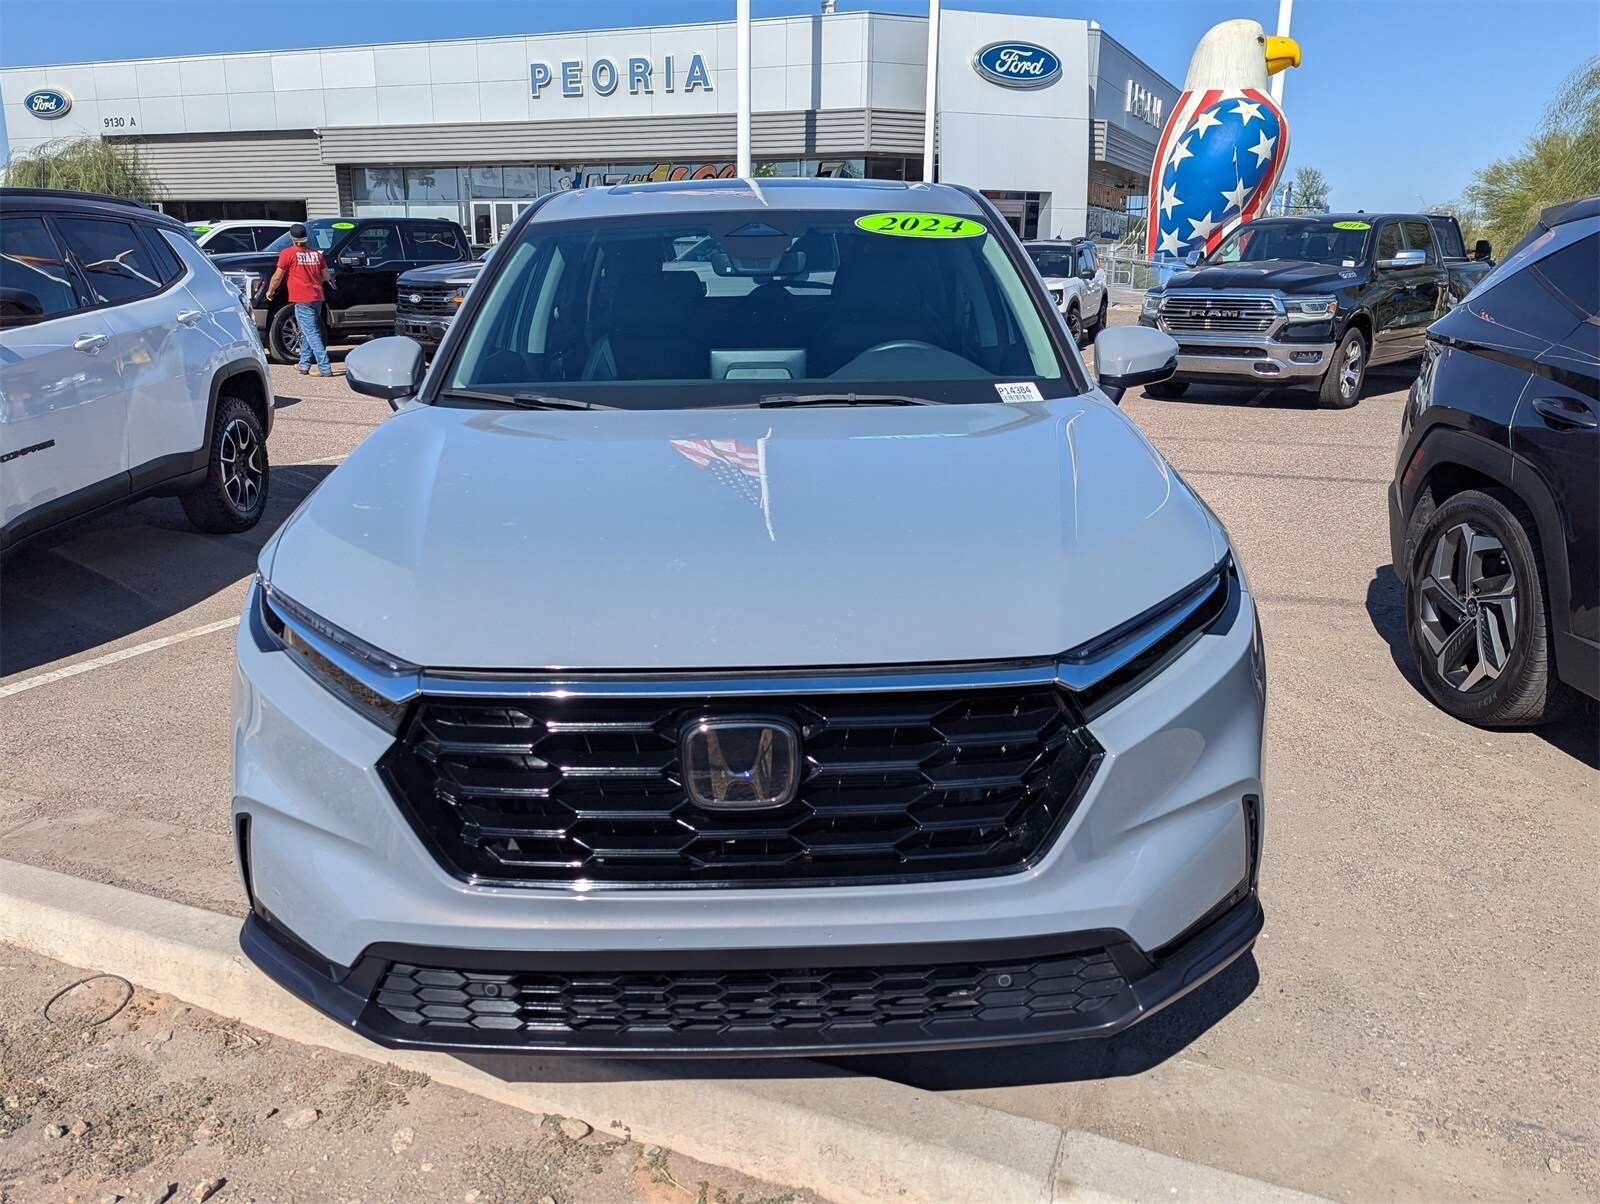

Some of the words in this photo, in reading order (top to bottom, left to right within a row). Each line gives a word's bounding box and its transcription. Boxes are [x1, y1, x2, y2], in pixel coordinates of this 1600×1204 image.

[995, 49, 1046, 75] Ford
[529, 52, 714, 99] PEORIA
[32, 95, 57, 111] Ford
[103, 117, 125, 128] 9130
[129, 117, 137, 127] A
[877, 217, 964, 233] 2024
[296, 252, 319, 263] STAFF
[1191, 309, 1239, 318] RAM
[998, 385, 1032, 395] P14384
